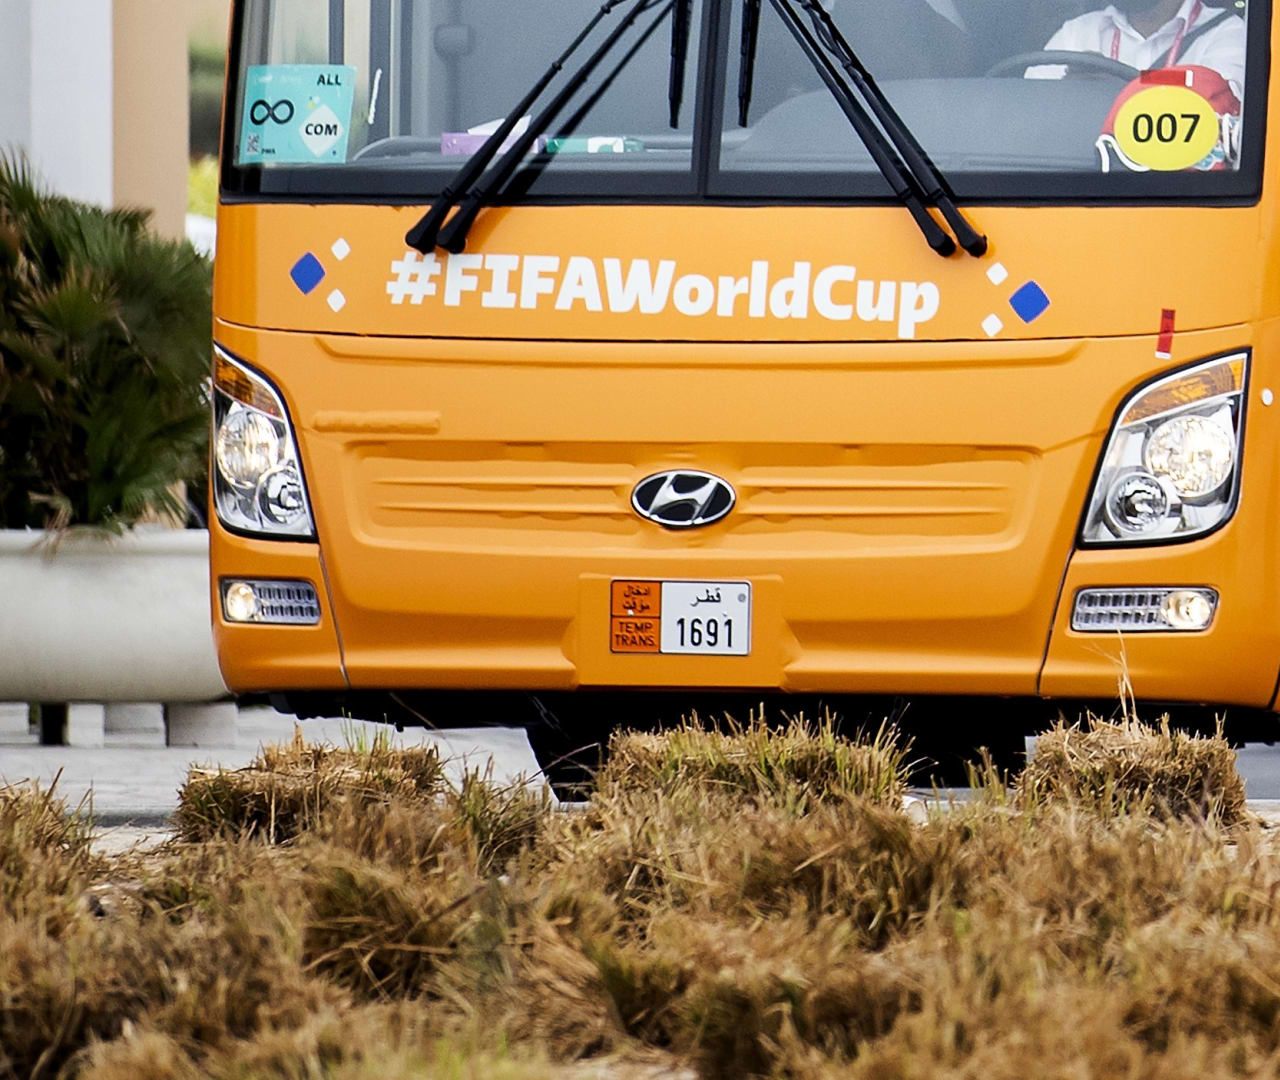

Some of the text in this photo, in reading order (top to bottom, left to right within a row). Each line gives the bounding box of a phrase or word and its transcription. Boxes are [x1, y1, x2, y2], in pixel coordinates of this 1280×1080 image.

[316, 73, 342, 87] ALL
[304, 123, 339, 137] COM
[1132, 113, 1201, 144] 007
[386, 251, 940, 339] #FIFAWorldCup
[689, 587, 722, 608] قطر
[676, 617, 733, 648] 1691
